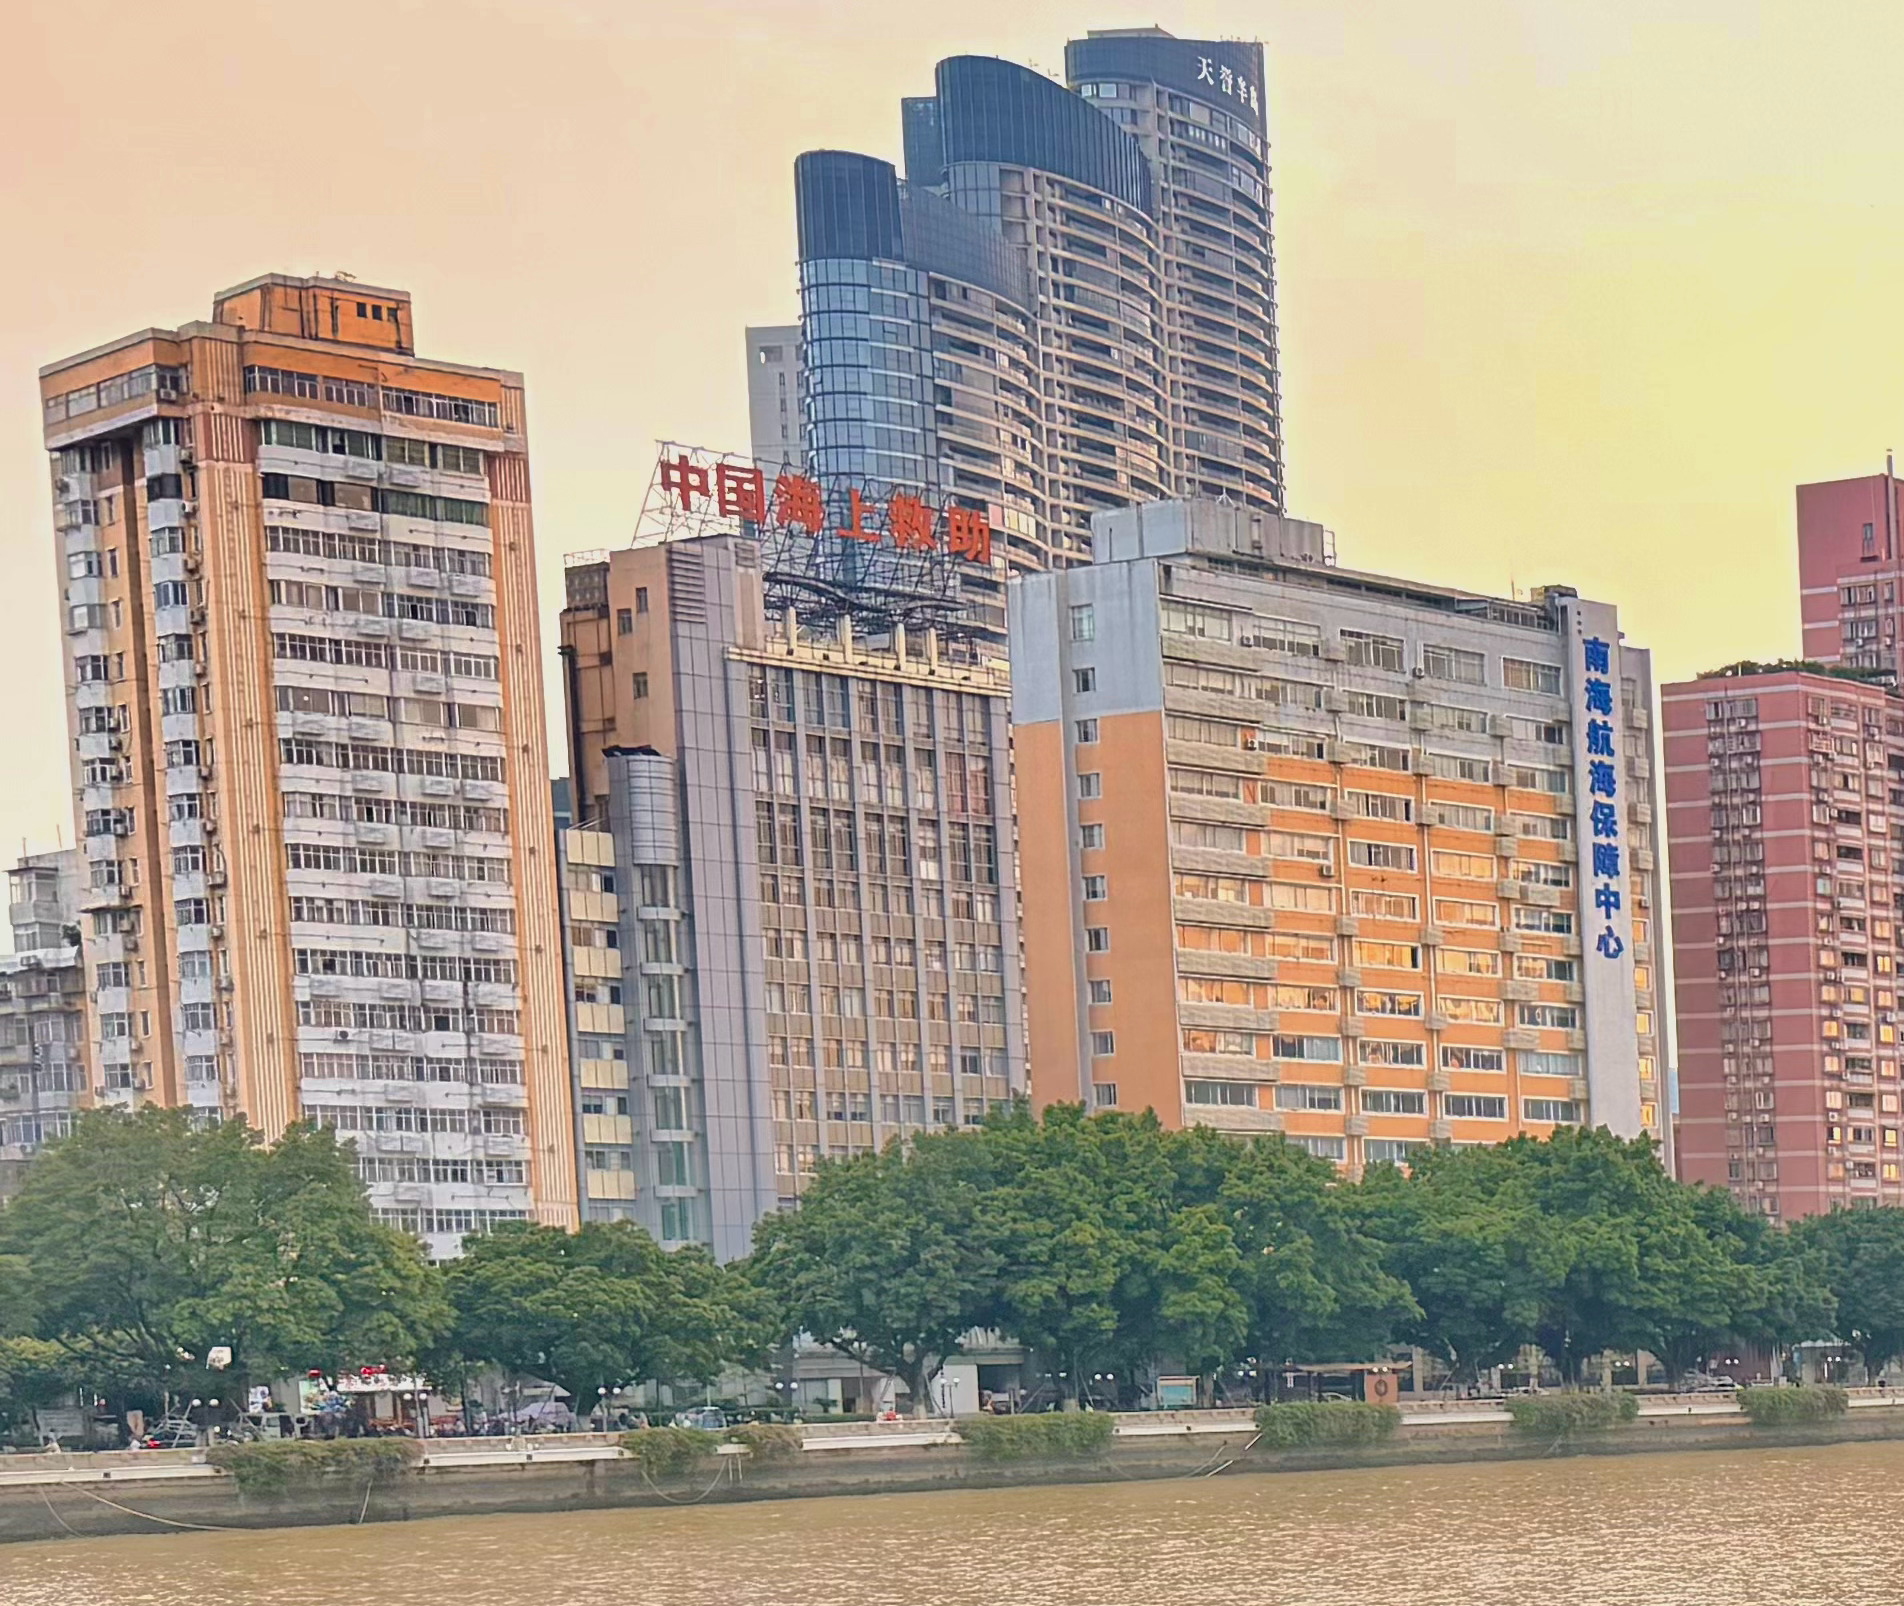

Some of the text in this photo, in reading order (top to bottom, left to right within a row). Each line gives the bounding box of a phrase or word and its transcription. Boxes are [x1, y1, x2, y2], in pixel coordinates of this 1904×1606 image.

[660, 455, 991, 565] 中国海上救助
[1582, 635, 1624, 961] 南海航海保障中心
